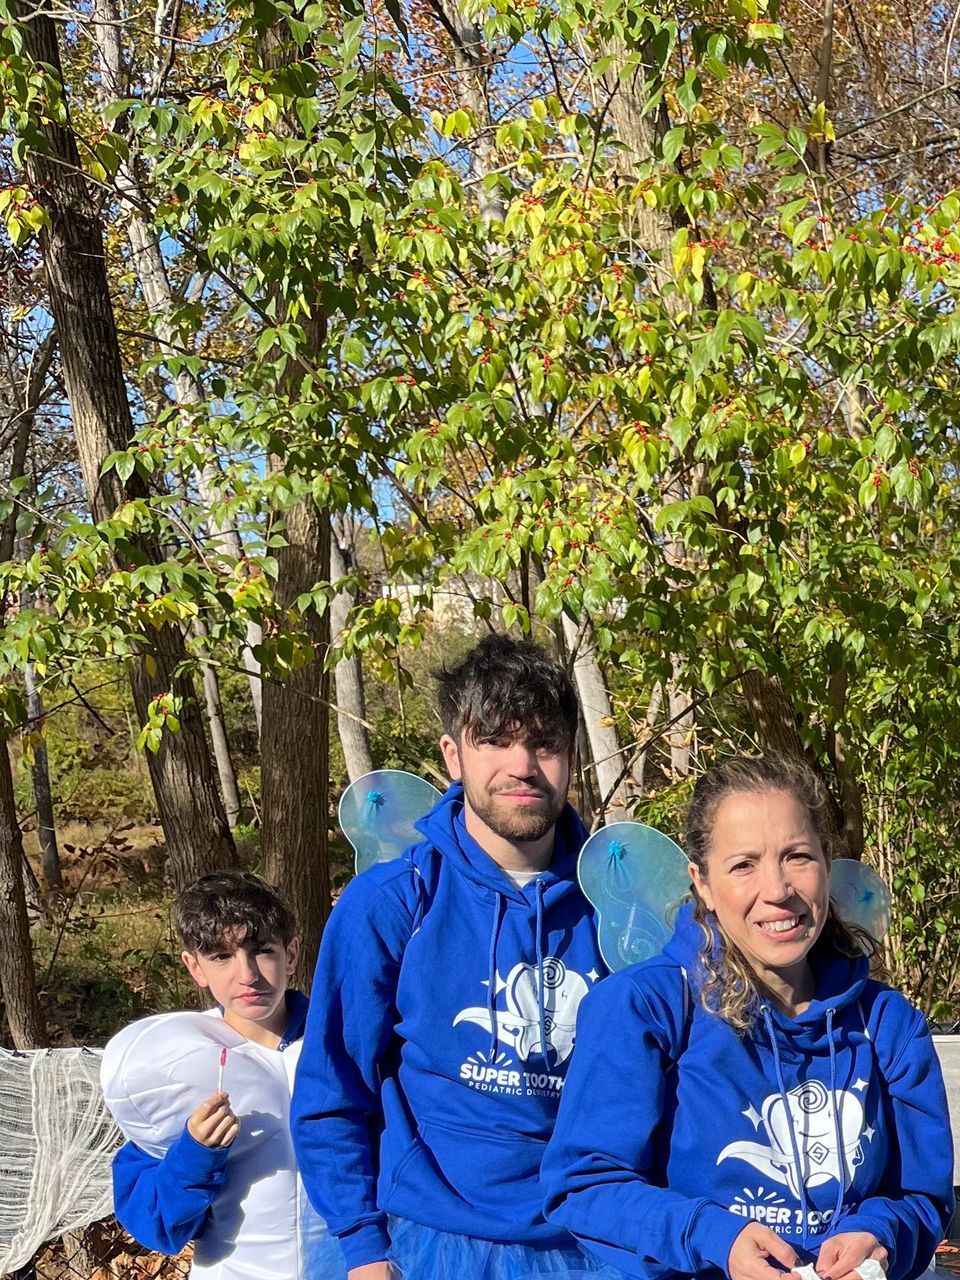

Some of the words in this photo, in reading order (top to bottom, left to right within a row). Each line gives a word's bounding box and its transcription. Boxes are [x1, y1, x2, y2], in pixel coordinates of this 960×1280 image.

[460, 1063, 520, 1087] SUPER
[523, 1072, 566, 1090] TOOTH
[468, 1081, 523, 1096] PEDIATRIC
[729, 1203, 792, 1224] SUPER
